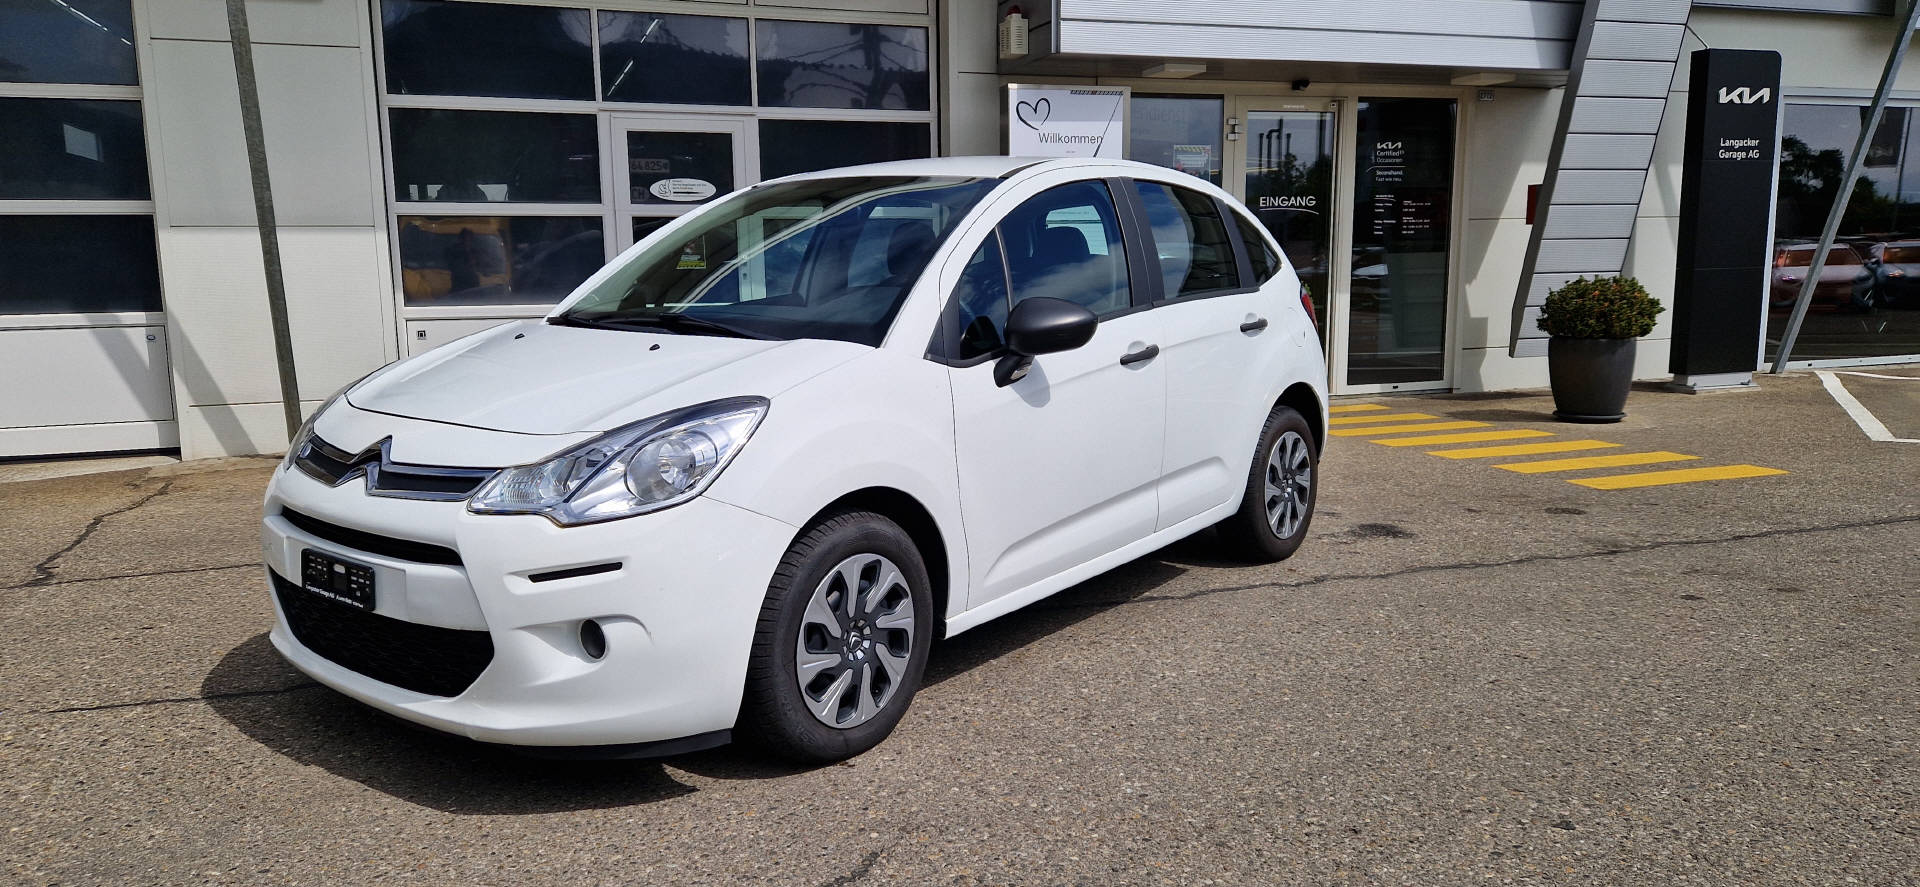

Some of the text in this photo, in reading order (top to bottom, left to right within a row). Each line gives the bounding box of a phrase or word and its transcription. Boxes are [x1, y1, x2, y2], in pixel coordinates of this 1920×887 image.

[1719, 86, 1770, 104] KIA
[1038, 132, 1103, 144] Willkommen
[1720, 137, 1759, 149] Langacker
[1376, 141, 1402, 149] KIA
[1719, 149, 1760, 160] Garage AG
[1260, 195, 1317, 207] EINGANG
